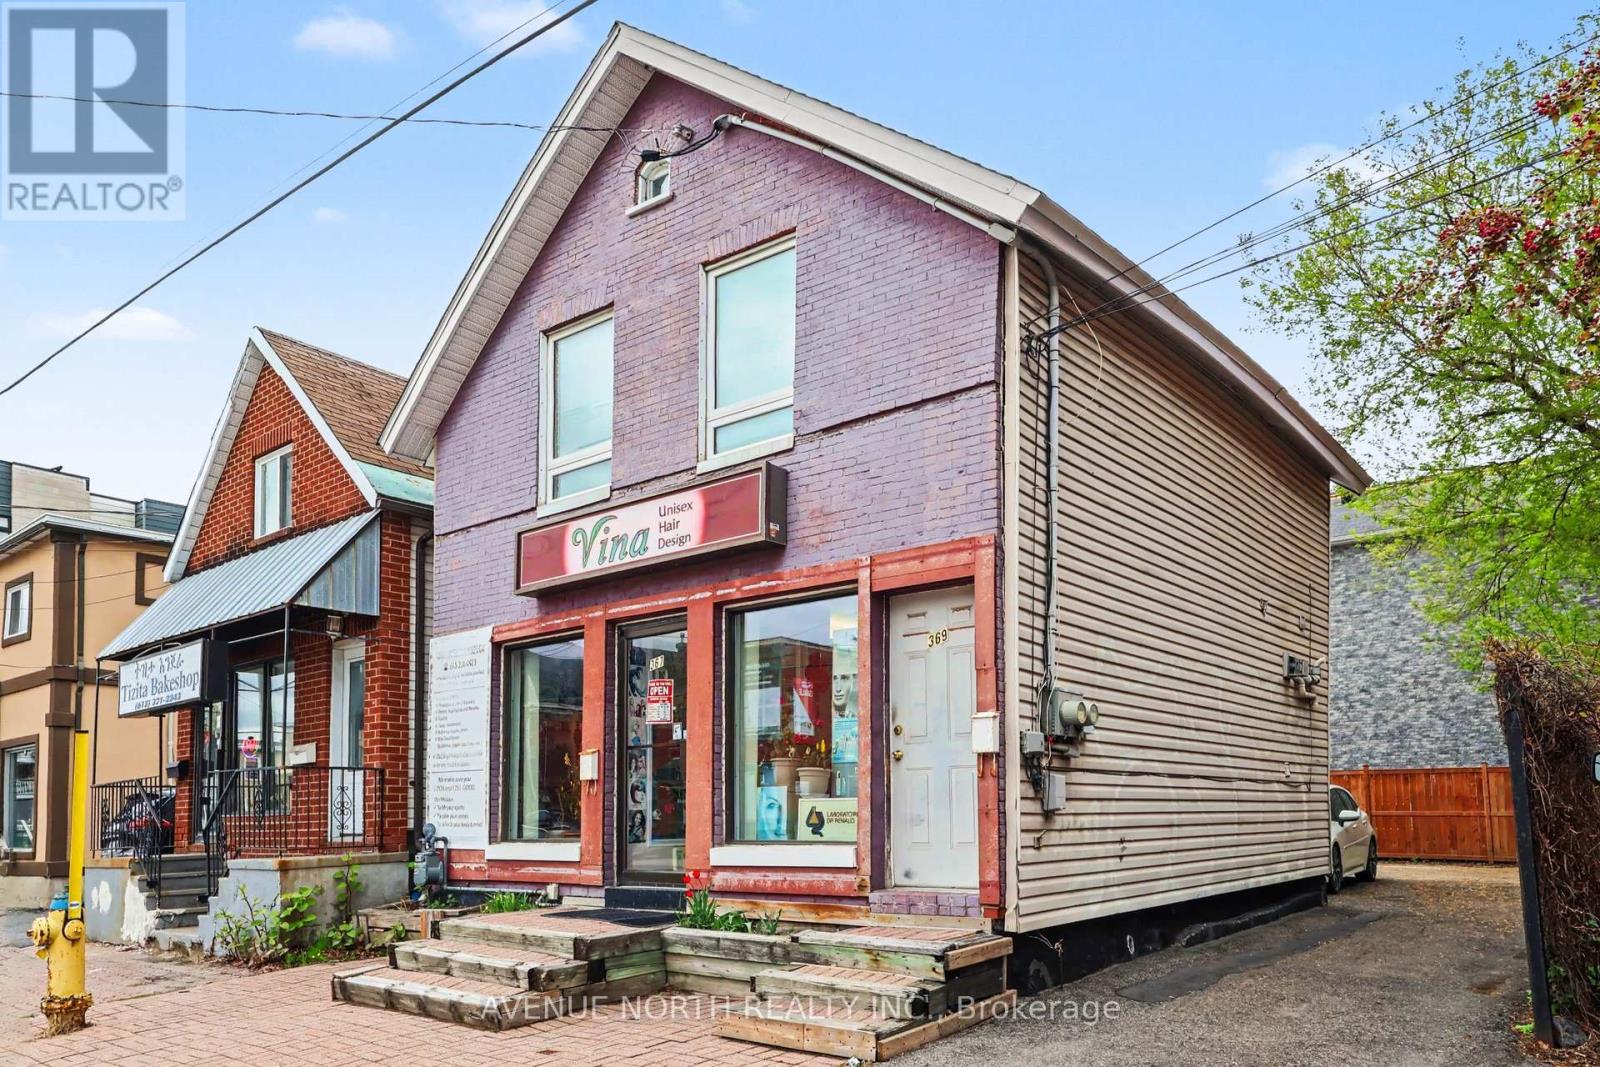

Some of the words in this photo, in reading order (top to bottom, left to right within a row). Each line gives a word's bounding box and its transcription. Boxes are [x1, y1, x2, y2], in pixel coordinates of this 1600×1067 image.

[658, 501, 694, 517] Unisex
[658, 519, 681, 534] Hair
[572, 515, 650, 569] Vina
[657, 533, 692, 550] Design
[928, 629, 948, 648] 369
[121, 682, 148, 703] Tizita
[151, 671, 199, 695] Bakeshop
[650, 686, 669, 695] OPEN
